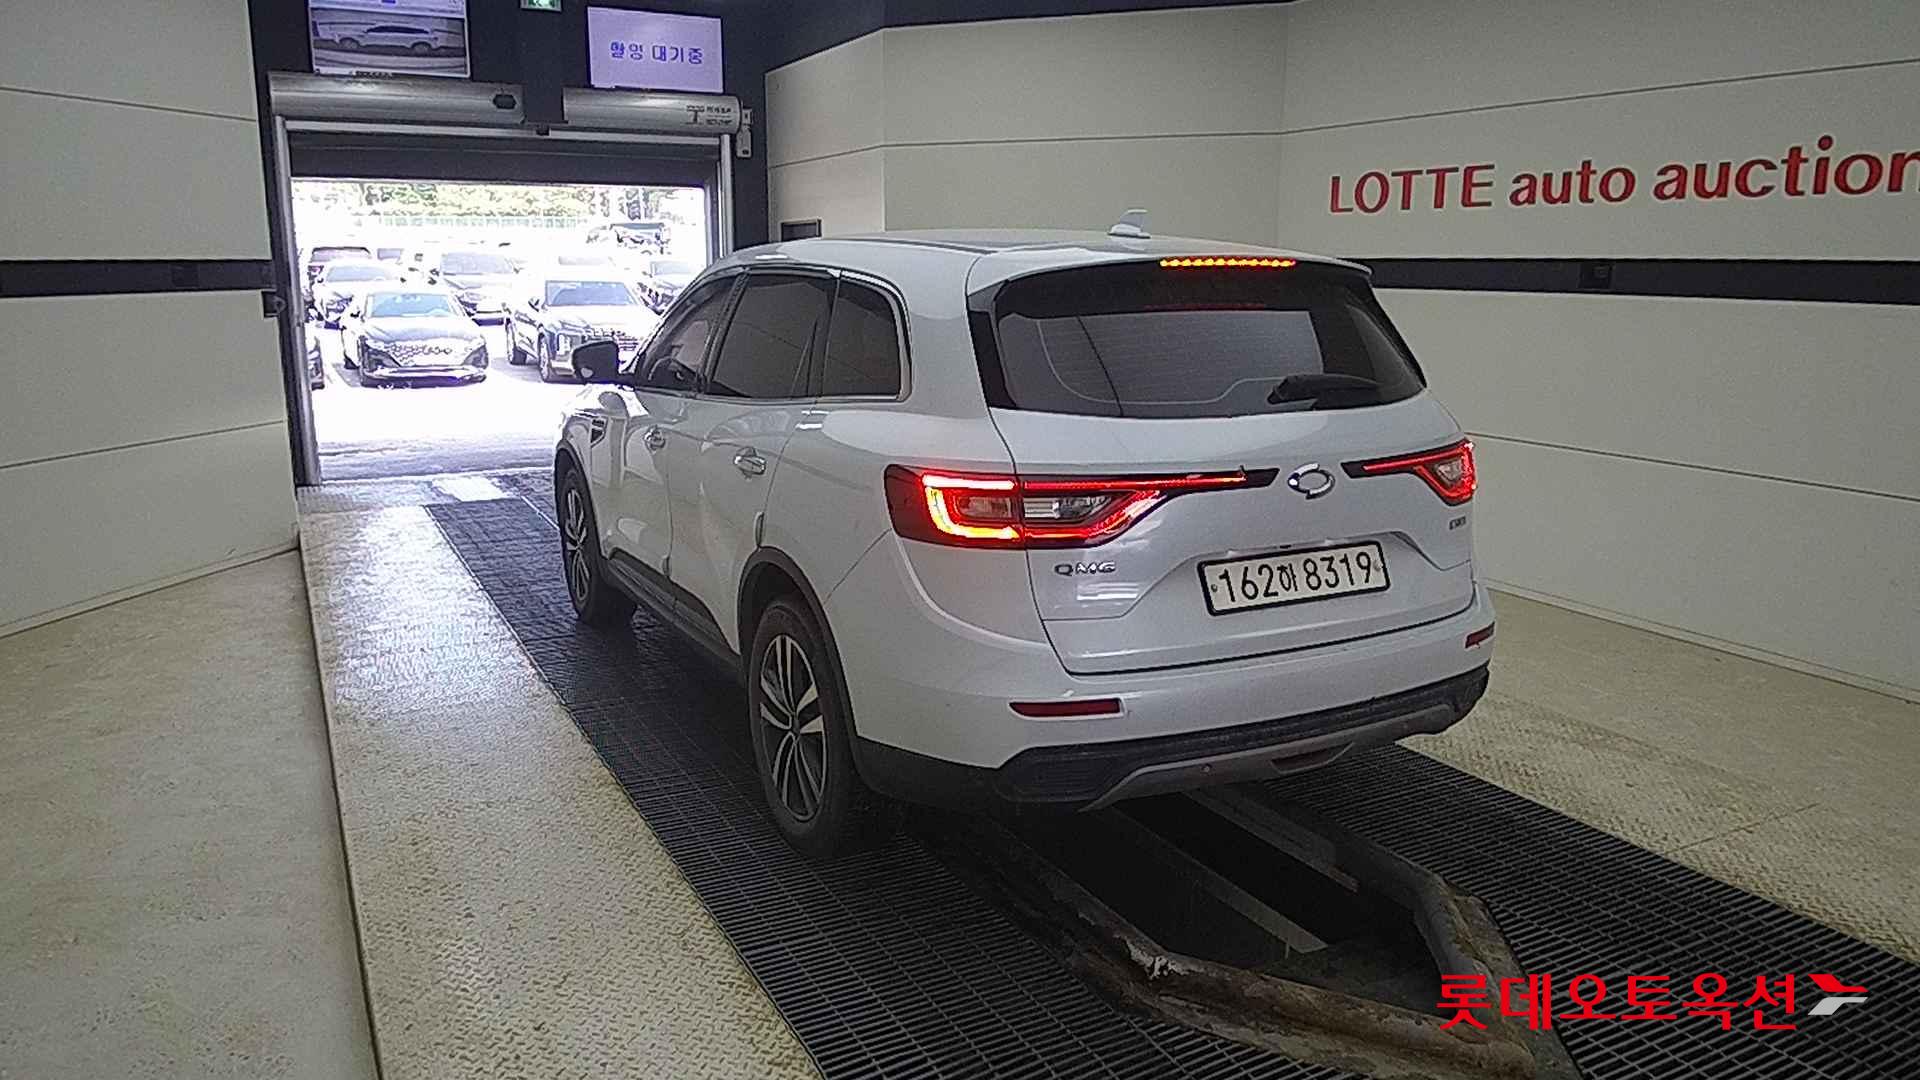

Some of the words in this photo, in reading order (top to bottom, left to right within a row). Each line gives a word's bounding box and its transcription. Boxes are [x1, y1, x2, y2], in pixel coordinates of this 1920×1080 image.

[652, 45, 703, 65] 대기중
[1330, 164, 1495, 213] LOTTE
[1509, 160, 1636, 206] auto
[1303, 551, 1372, 591] 8319
